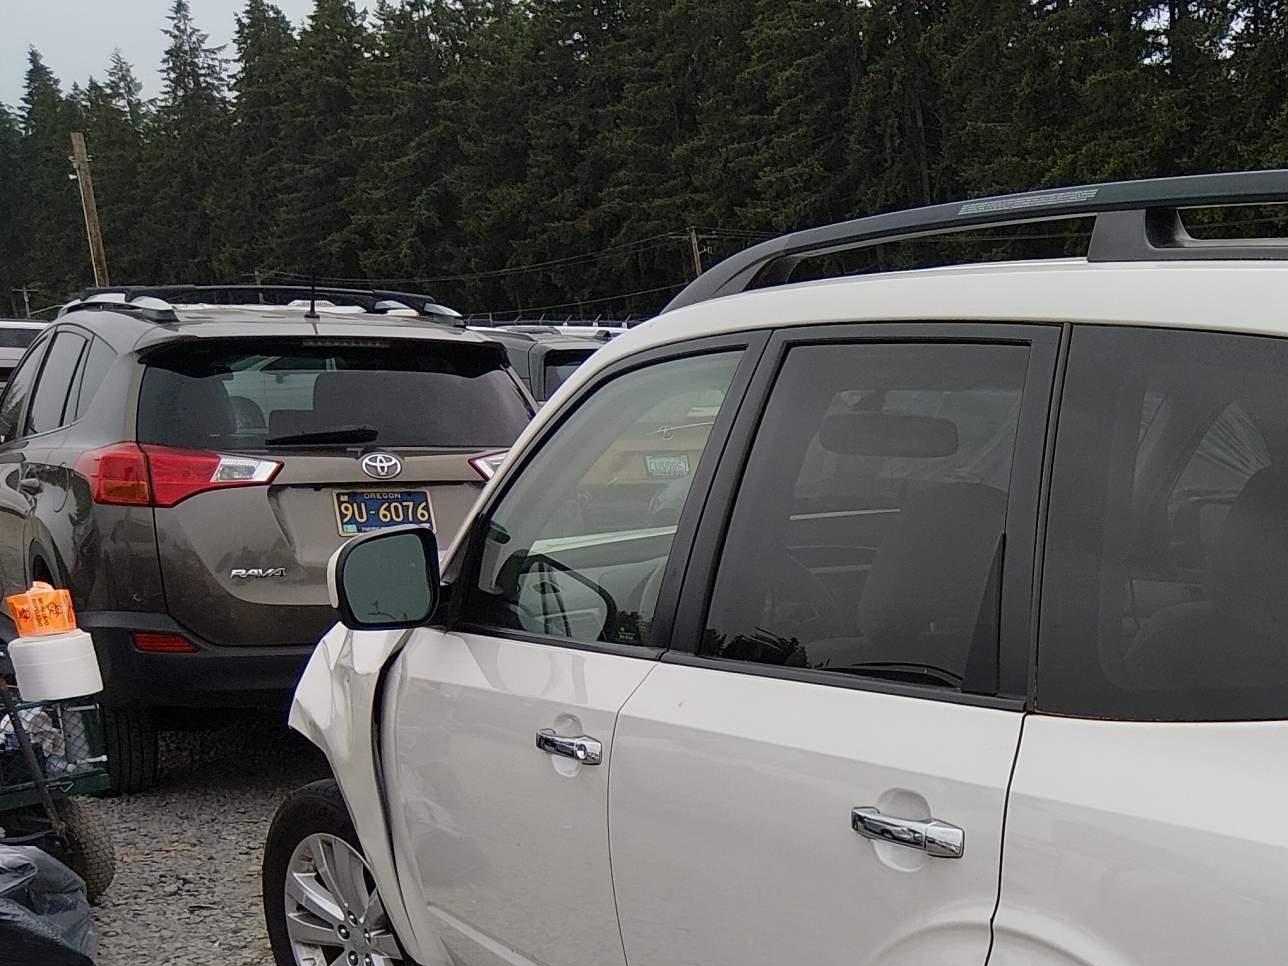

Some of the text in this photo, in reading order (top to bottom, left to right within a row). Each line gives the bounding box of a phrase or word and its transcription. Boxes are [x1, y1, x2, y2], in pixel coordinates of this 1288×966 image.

[363, 492, 401, 500] OREGON
[340, 501, 429, 523] 9U-6076
[230, 567, 287, 578] RAV4
